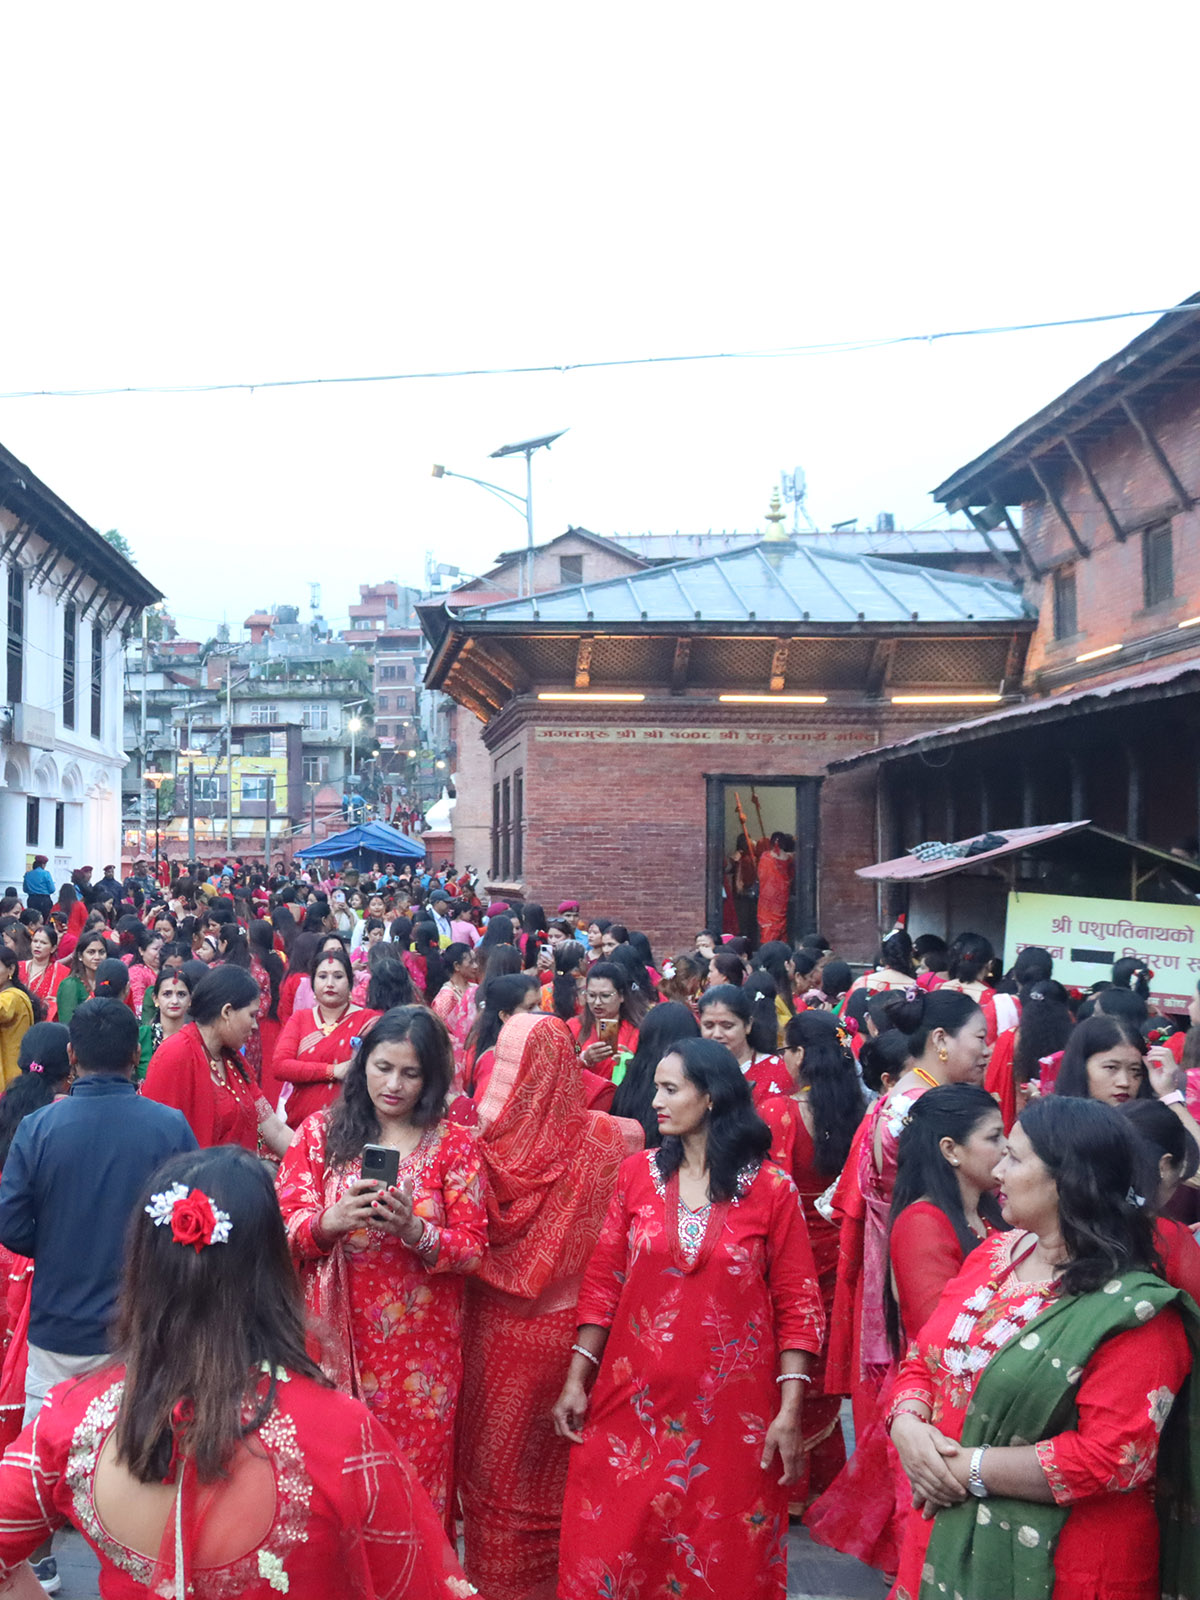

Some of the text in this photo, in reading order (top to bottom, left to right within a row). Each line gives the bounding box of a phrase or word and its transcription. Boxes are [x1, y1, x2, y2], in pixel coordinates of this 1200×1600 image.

[616, 729, 636, 739] श्री
[643, 729, 663, 739] श्री
[719, 730, 739, 740] श्री
[1052, 915, 1195, 943] श्री पशुपतिनाथको
